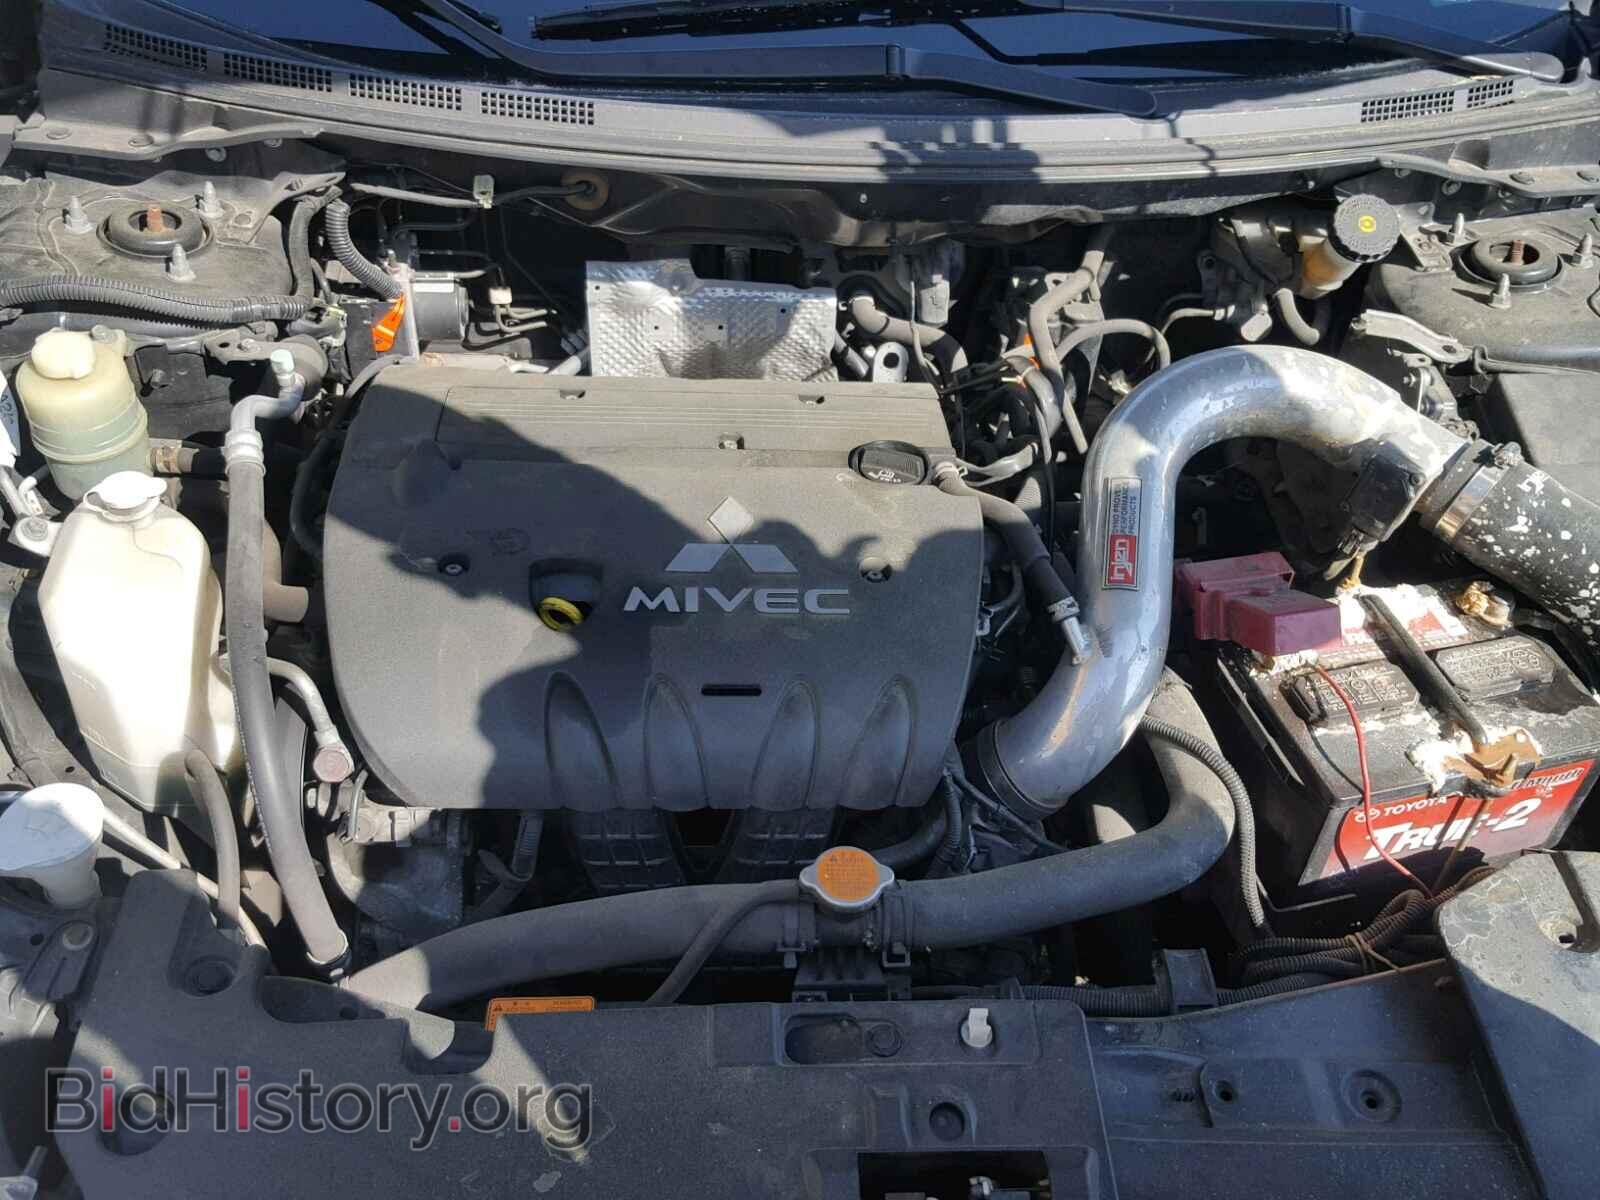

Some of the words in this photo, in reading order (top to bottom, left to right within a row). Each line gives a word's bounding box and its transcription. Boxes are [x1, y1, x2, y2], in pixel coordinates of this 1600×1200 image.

[1128, 496, 1136, 534] PRODUCTS
[623, 586, 850, 614] MIVEC
[1383, 797, 1448, 816] TOYOTA
